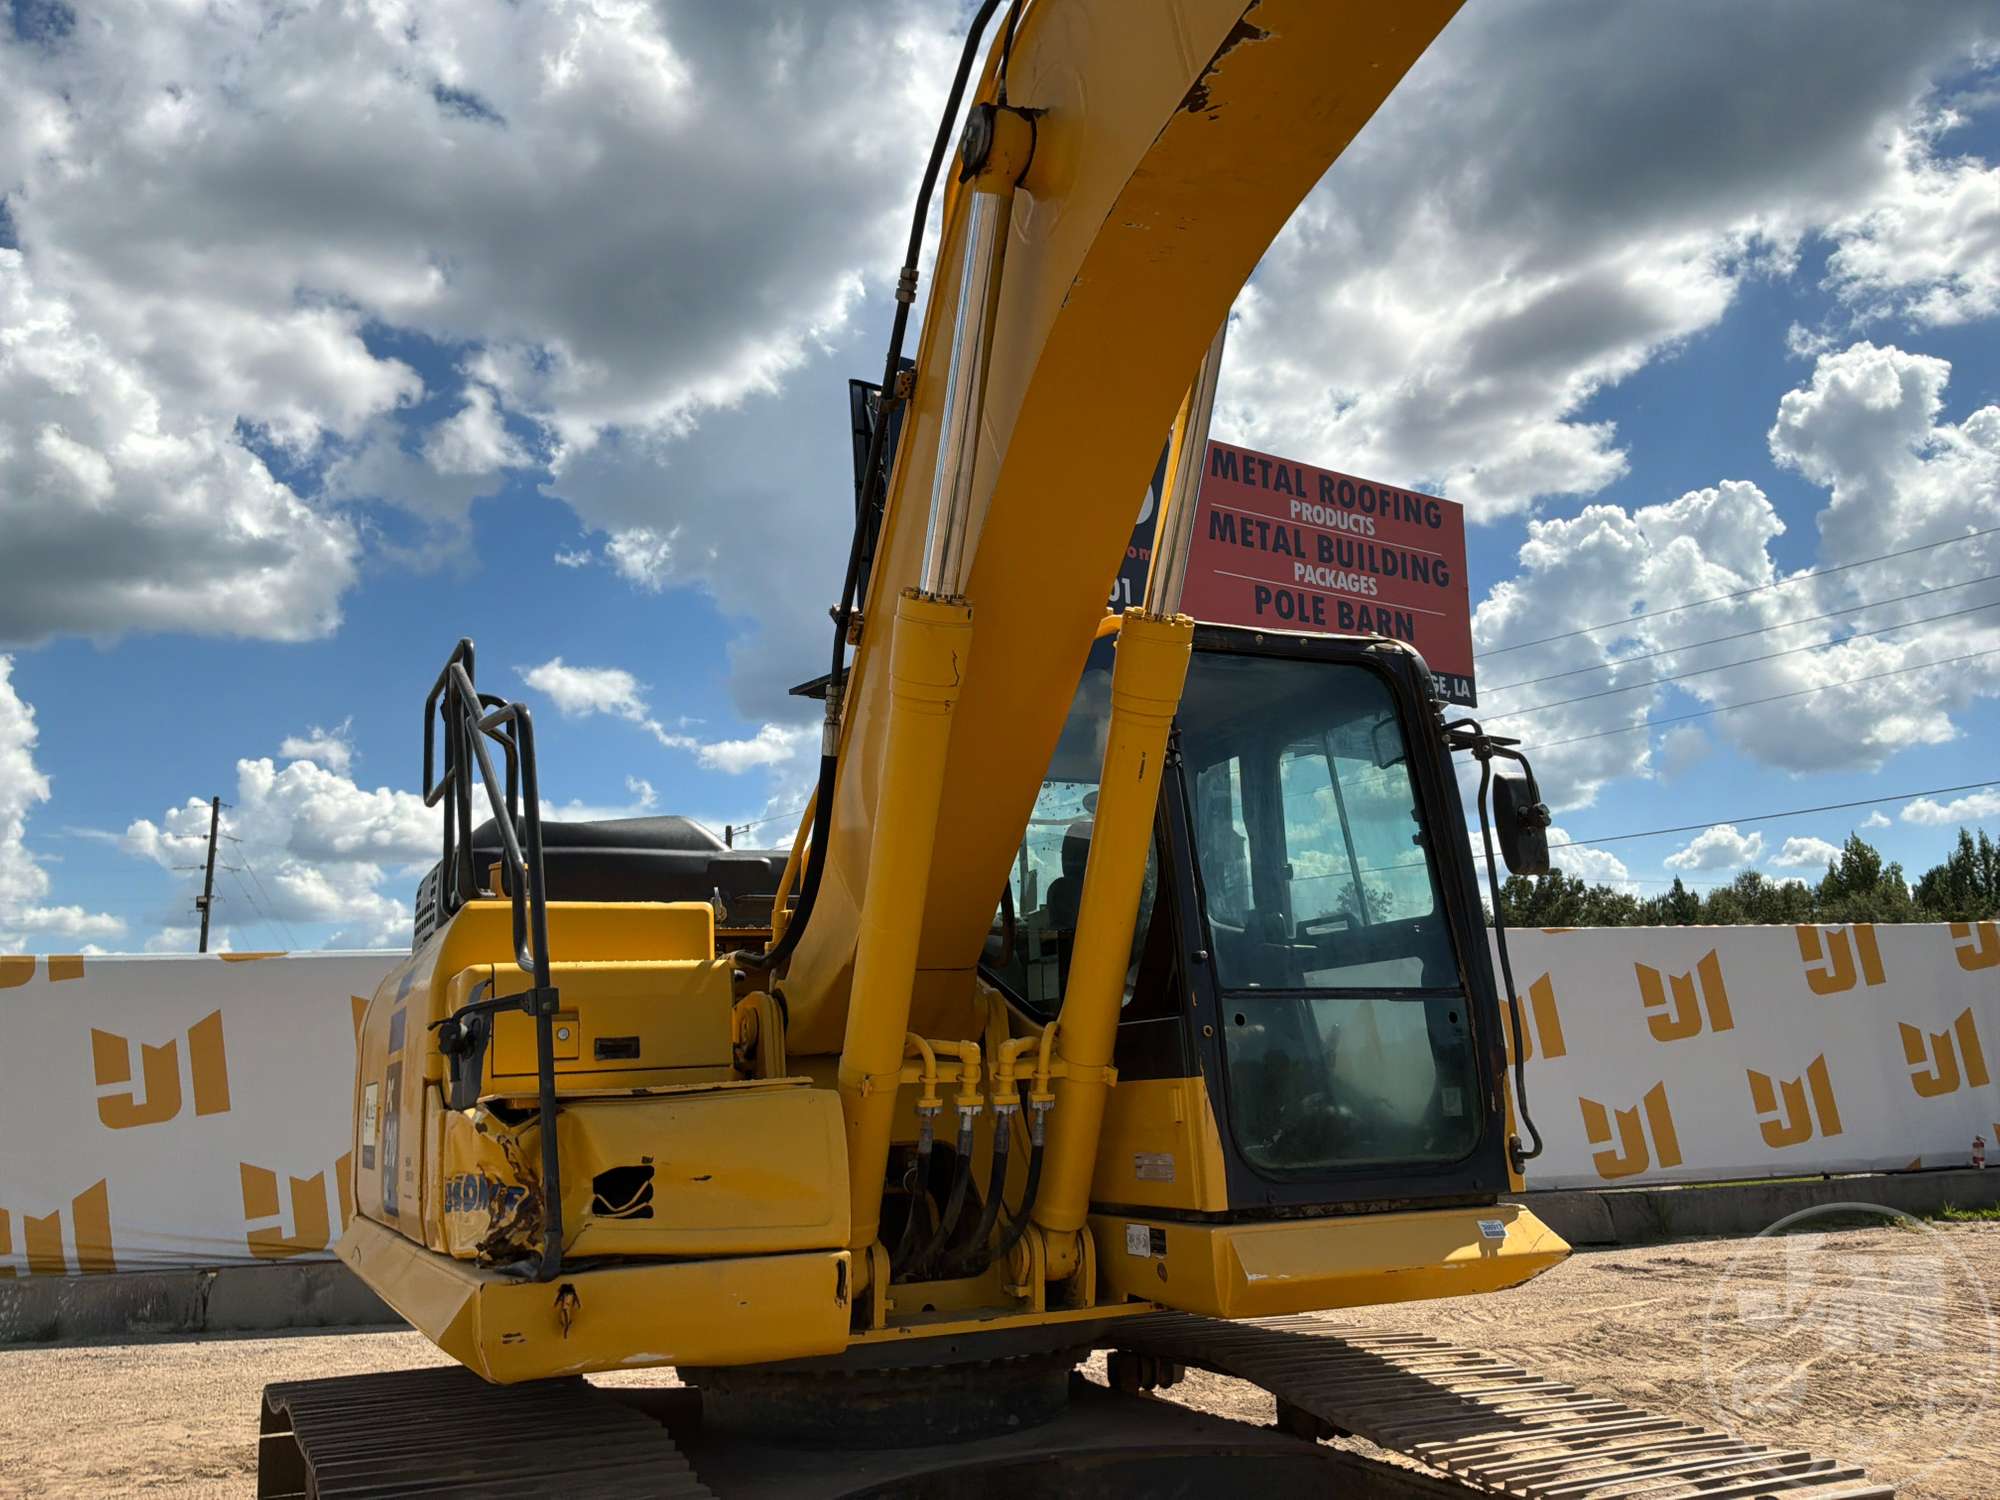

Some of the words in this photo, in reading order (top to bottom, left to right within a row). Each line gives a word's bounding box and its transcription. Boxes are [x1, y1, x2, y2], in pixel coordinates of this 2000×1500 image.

[1211, 447, 1307, 499] METAL
[1319, 474, 1442, 530] ROOFING
[1289, 499, 1376, 537] PRODUCTS
[1209, 511, 1306, 559] METAL
[1317, 535, 1450, 589] BUILDING
[1293, 562, 1378, 597] PACKAGES
[1254, 585, 1326, 627] POLE
[1337, 602, 1414, 642] BARN
[1454, 678, 1471, 698] LA
